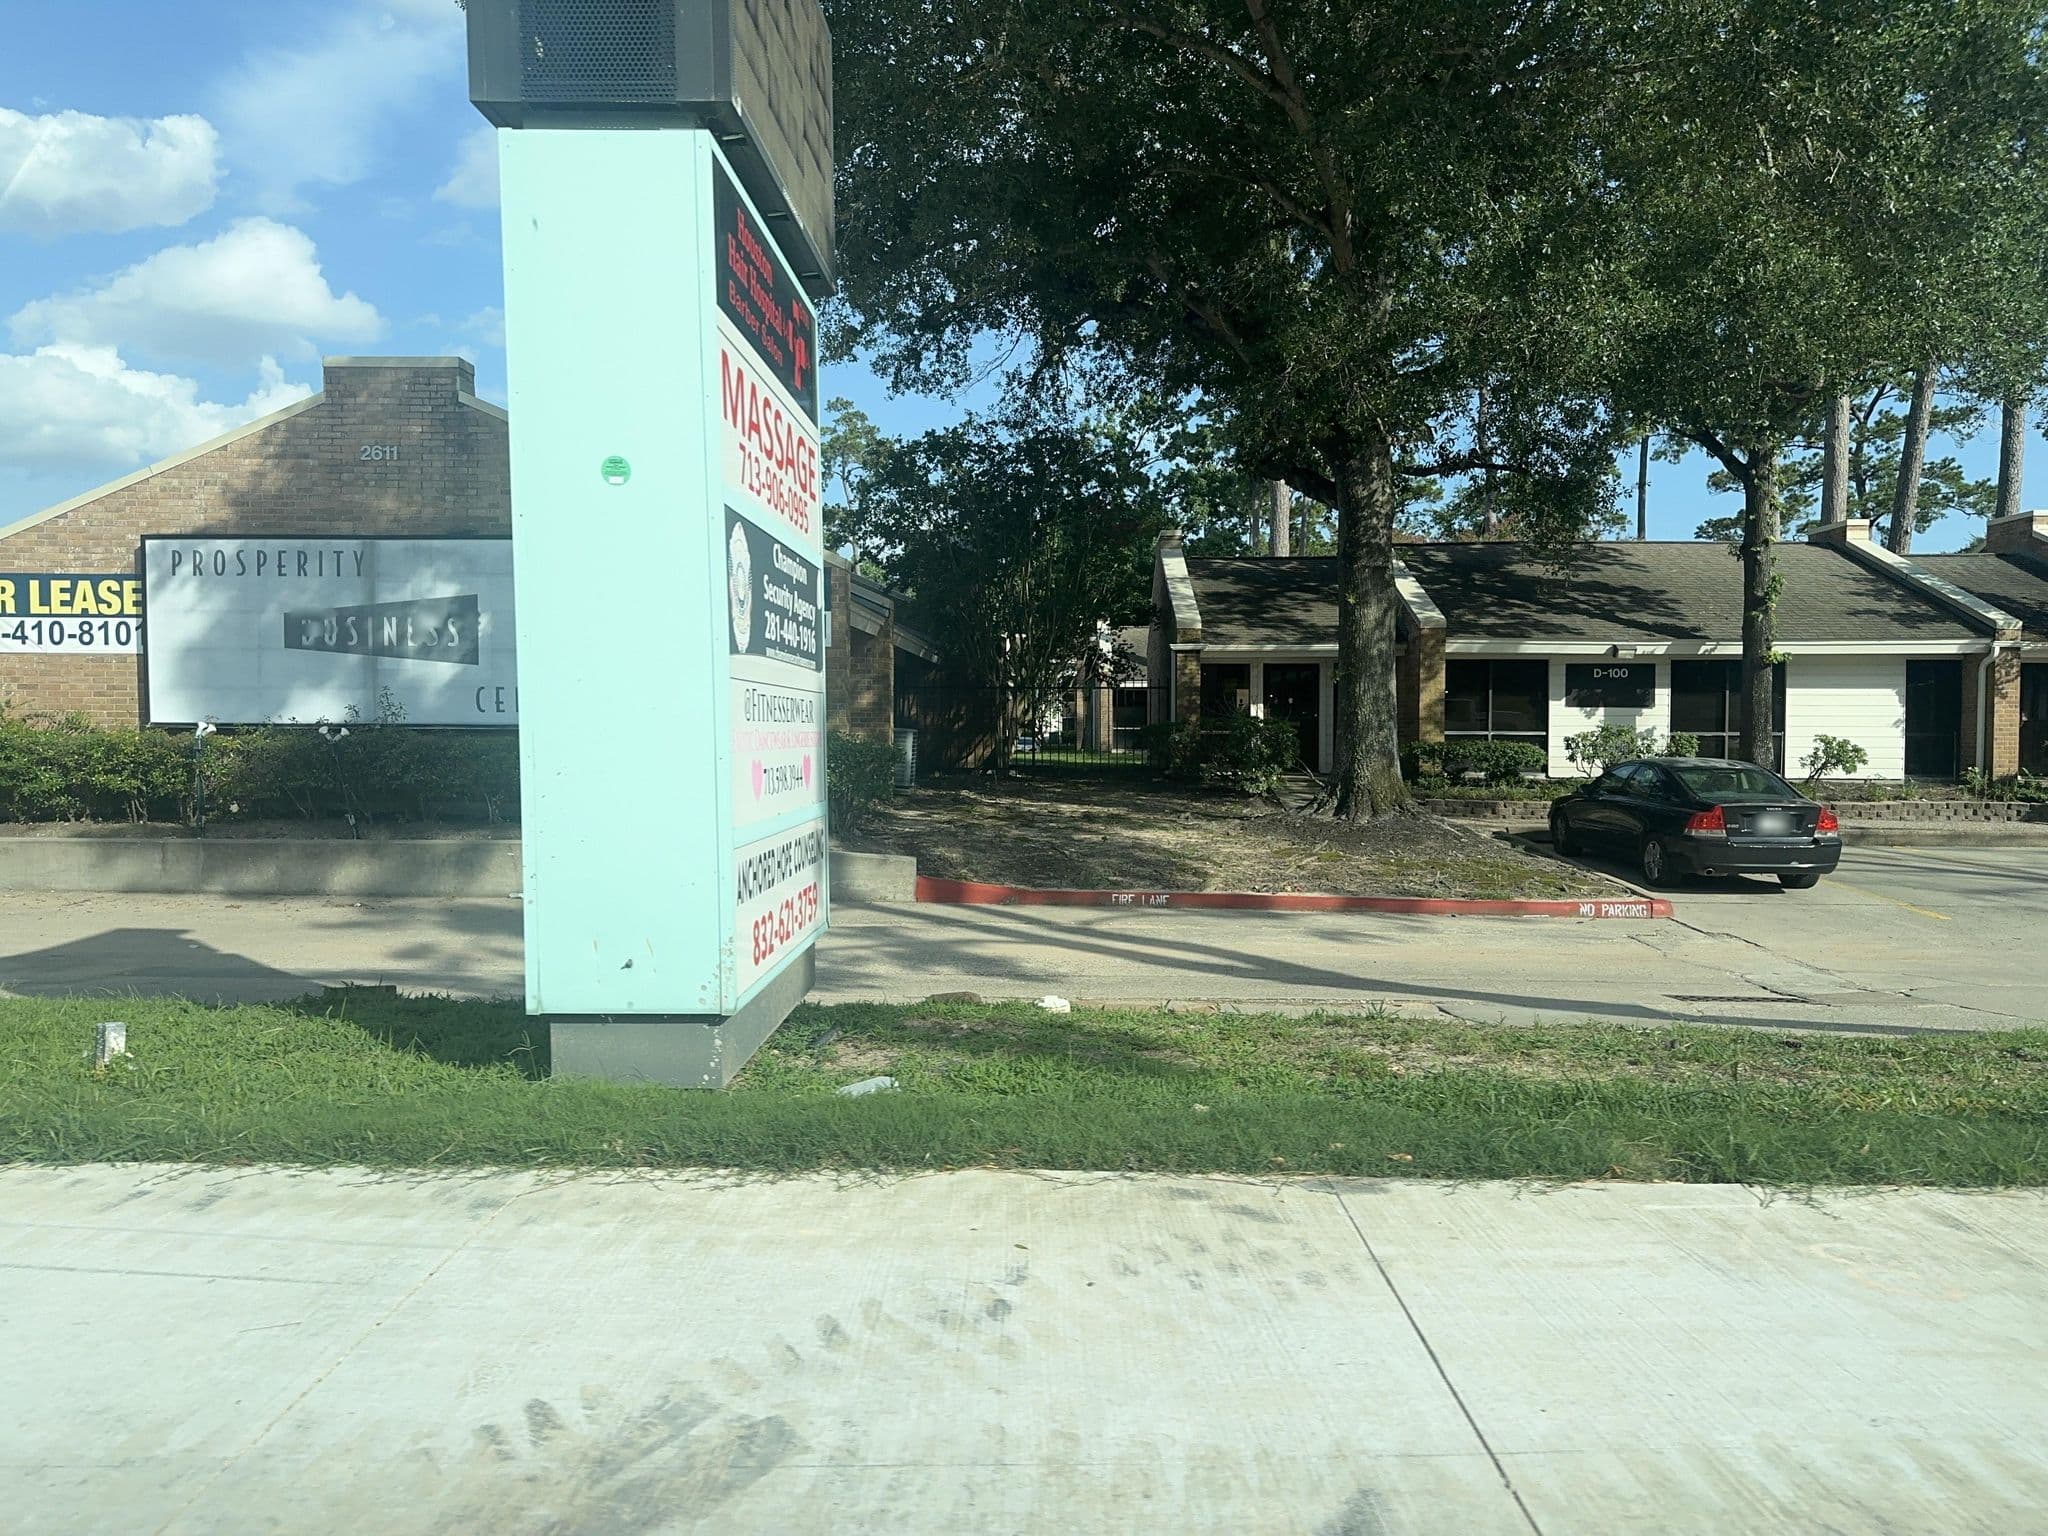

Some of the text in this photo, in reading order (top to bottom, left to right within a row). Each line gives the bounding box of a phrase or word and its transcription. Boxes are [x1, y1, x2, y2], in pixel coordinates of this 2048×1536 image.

[736, 207, 773, 288] Houston
[727, 233, 782, 337] Hair Hospital
[728, 280, 783, 367] Barber Salon
[721, 348, 816, 502] MASSAGE
[359, 445, 399, 461] 2611
[739, 442, 809, 534] 713-906-0995
[170, 549, 366, 577] PROSPERITY
[772, 543, 808, 586] Champion
[29, 579, 143, 615] LEASE
[763, 574, 817, 626] Security Agency
[764, 610, 816, 655] 281-440-1916
[1593, 668, 1629, 678] D-100
[475, 686, 519, 713] CE
[736, 848, 775, 906] ANCHORED
[776, 841, 792, 884] HOPE
[752, 881, 818, 966] 832-621-3759
[1579, 903, 1647, 917] NO PARKING
